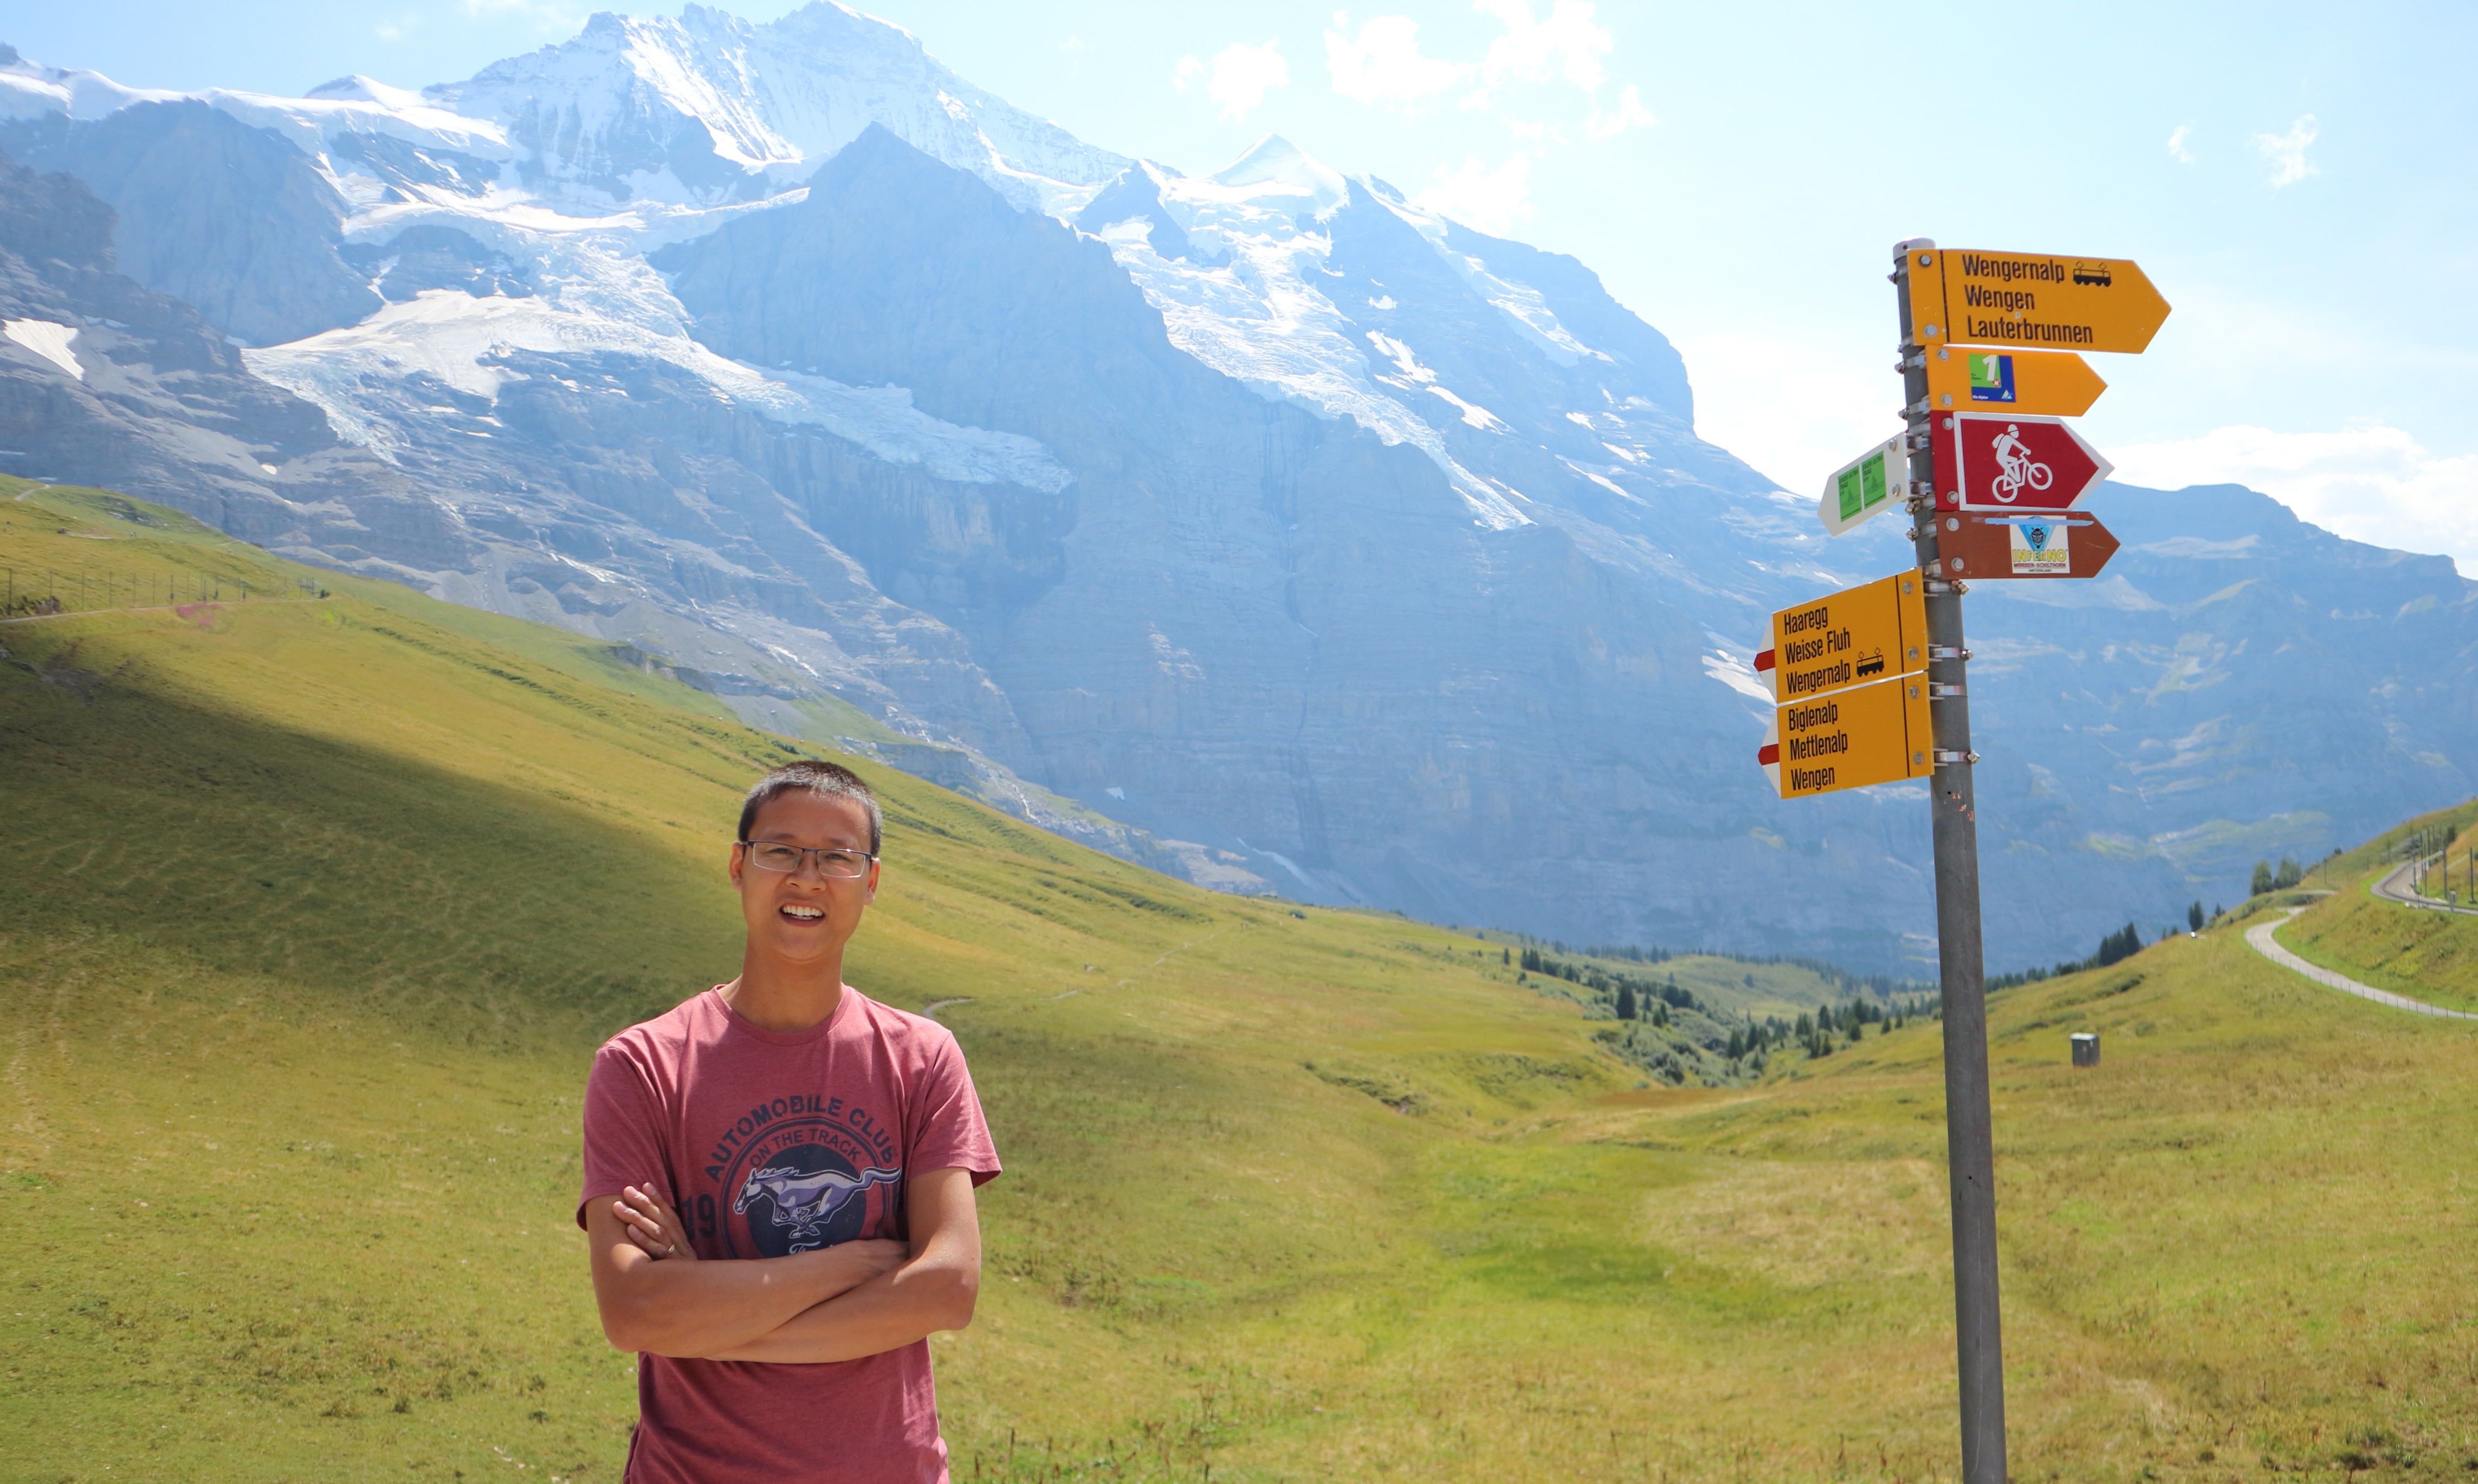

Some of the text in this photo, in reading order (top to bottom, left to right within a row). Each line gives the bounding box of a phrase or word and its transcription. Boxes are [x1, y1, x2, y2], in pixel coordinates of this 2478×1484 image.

[1962, 254, 2065, 283] Wengernalp
[1964, 284, 2035, 312] Wengen
[1968, 315, 2093, 344] Lauterbrunnen
[1983, 354, 1997, 381] 1
[1873, 454, 1883, 465] ULTRA
[2013, 549, 2067, 562] INFERNO
[1784, 606, 1828, 635] Haaregg
[1785, 627, 1851, 664] Weisse Fluh
[1787, 659, 1851, 694] Wengernalp
[1789, 701, 1838, 732] Biglenalp
[1790, 730, 1848, 761] Mettlenalp
[1791, 767, 1835, 790] Wengen
[706, 1095, 897, 1182] AUTOMOBILE CLUB
[749, 1129, 862, 1167] ON THE TRACK
